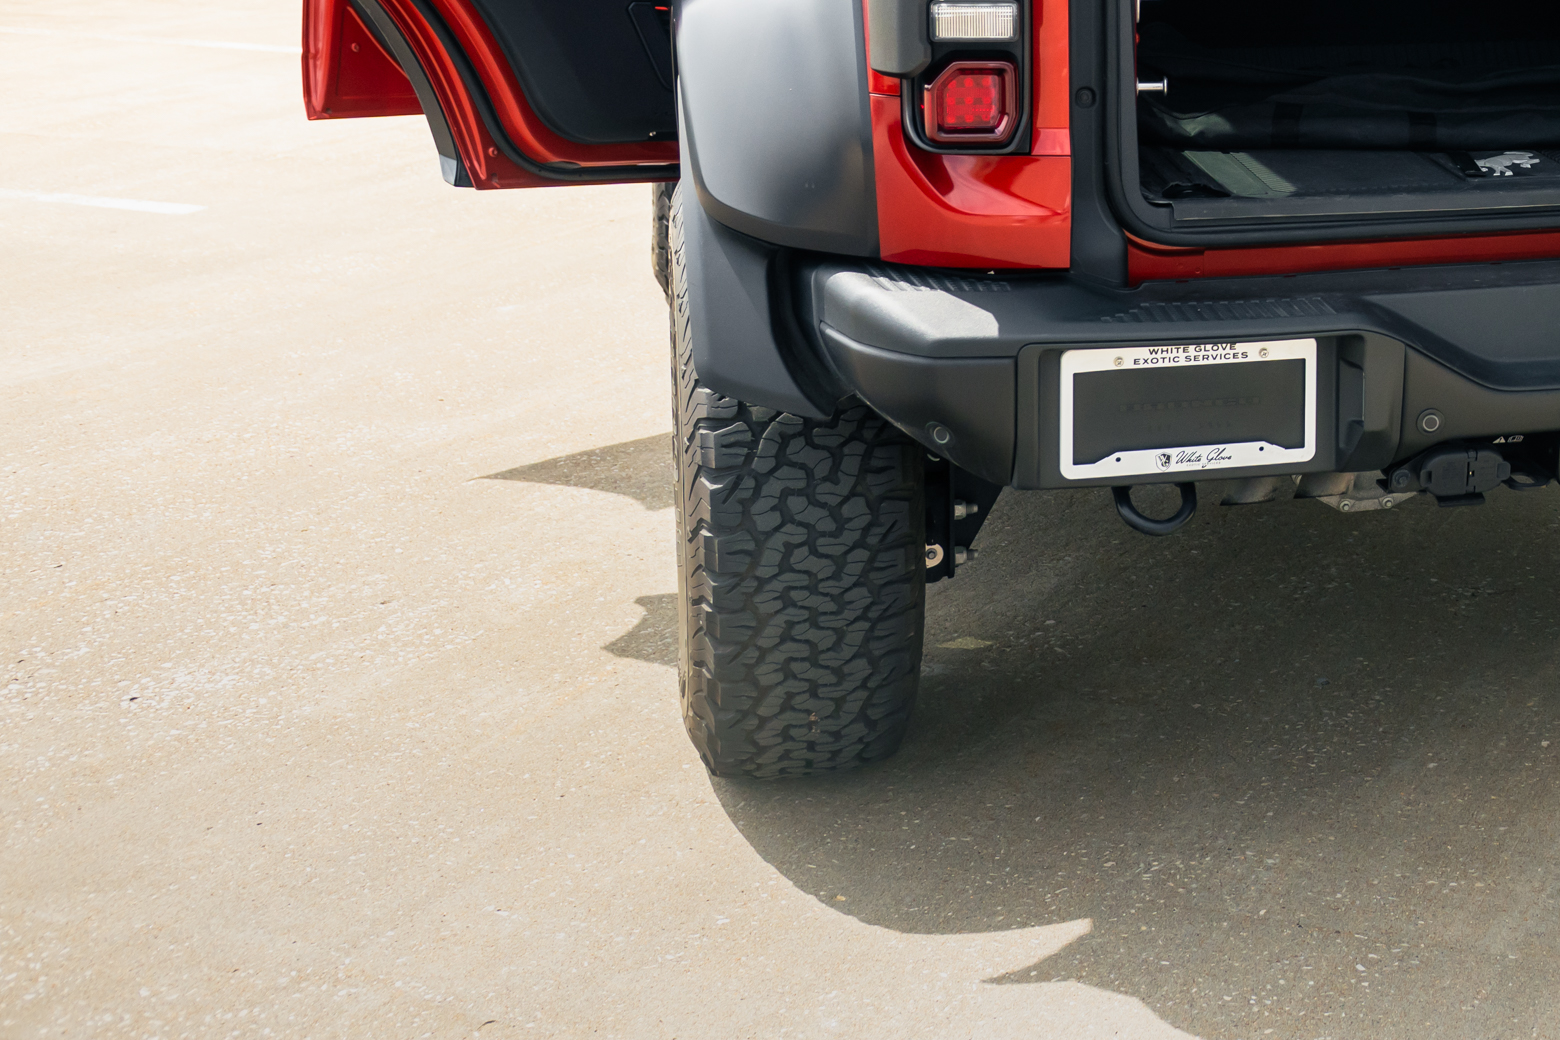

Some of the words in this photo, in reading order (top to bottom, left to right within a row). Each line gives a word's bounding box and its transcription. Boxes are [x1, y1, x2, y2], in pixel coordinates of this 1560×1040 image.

[1148, 346, 1190, 356] WHITE
[1194, 343, 1237, 353] GLOVE
[1133, 356, 1180, 366] EXOTIC
[1184, 351, 1249, 362] SERVICES
[1175, 450, 1203, 464] White
[1202, 447, 1232, 468] Glove
